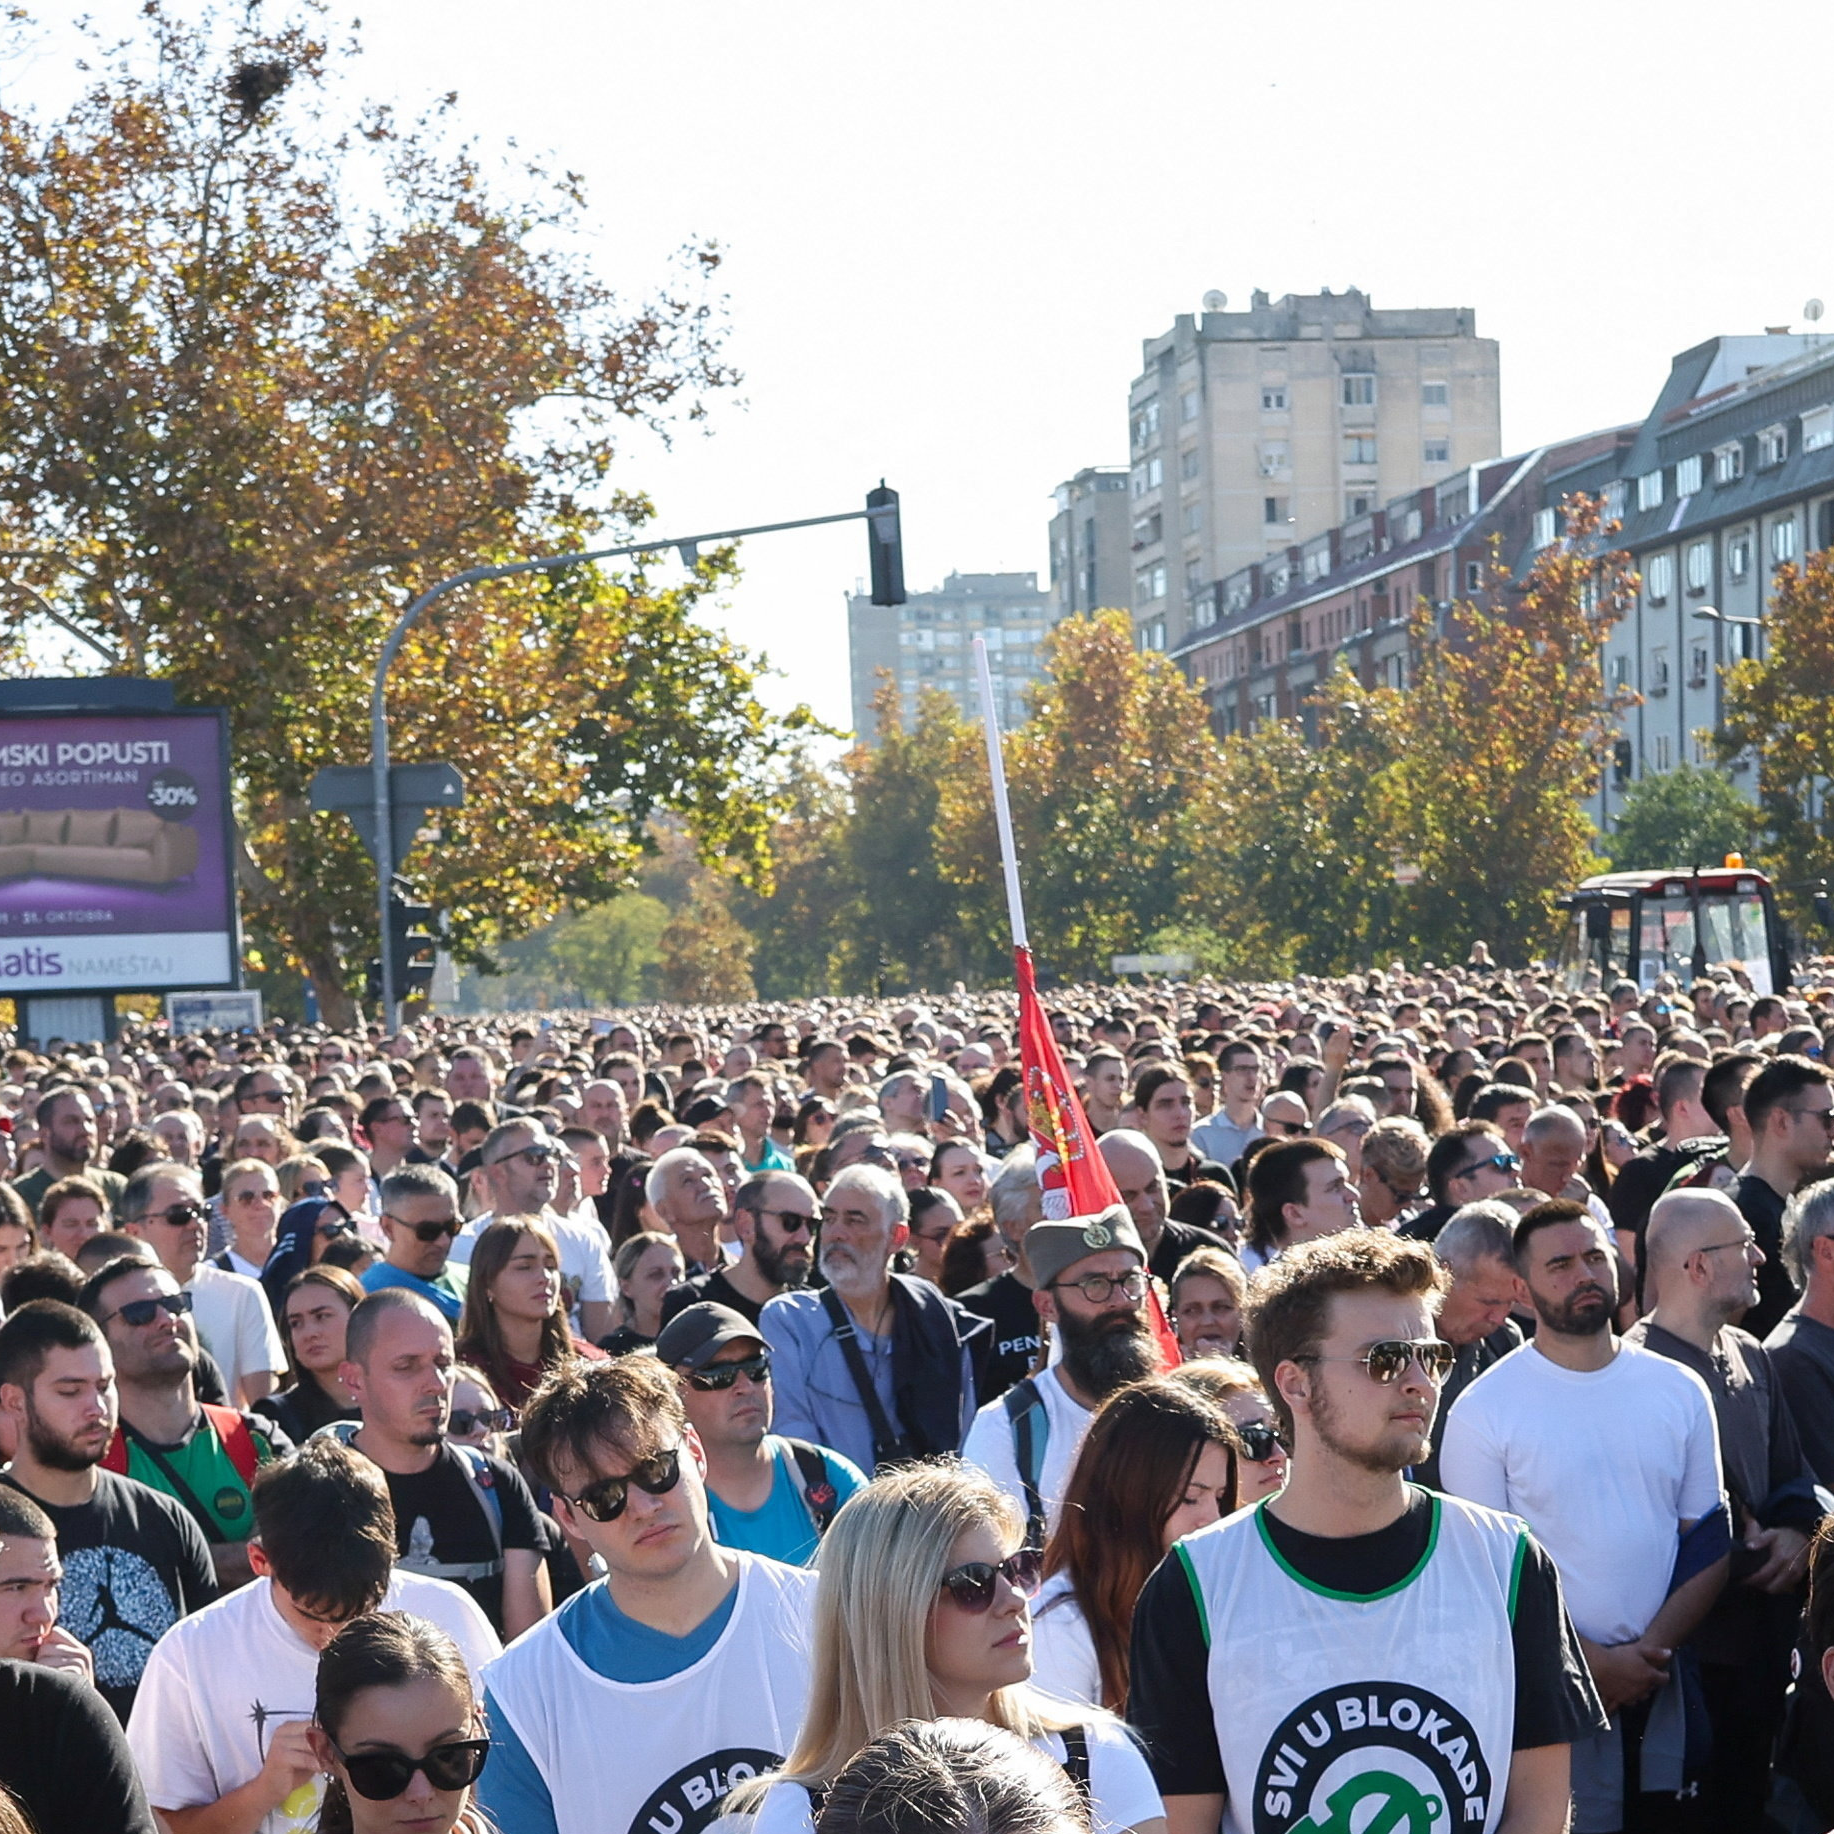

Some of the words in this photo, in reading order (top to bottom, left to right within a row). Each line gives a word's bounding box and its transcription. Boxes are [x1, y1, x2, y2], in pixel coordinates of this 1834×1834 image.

[56, 741, 171, 765] POPUSTI
[31, 769, 138, 786] ASORTIMAN
[147, 786, 198, 806] -30%
[68, 951, 174, 976] NAMEŠTAJ
[1263, 1743, 1307, 1819] SVI
[1297, 1711, 1331, 1746] U
[1336, 1695, 1487, 1824] BLOKADE
[680, 1761, 769, 1811] BLO
